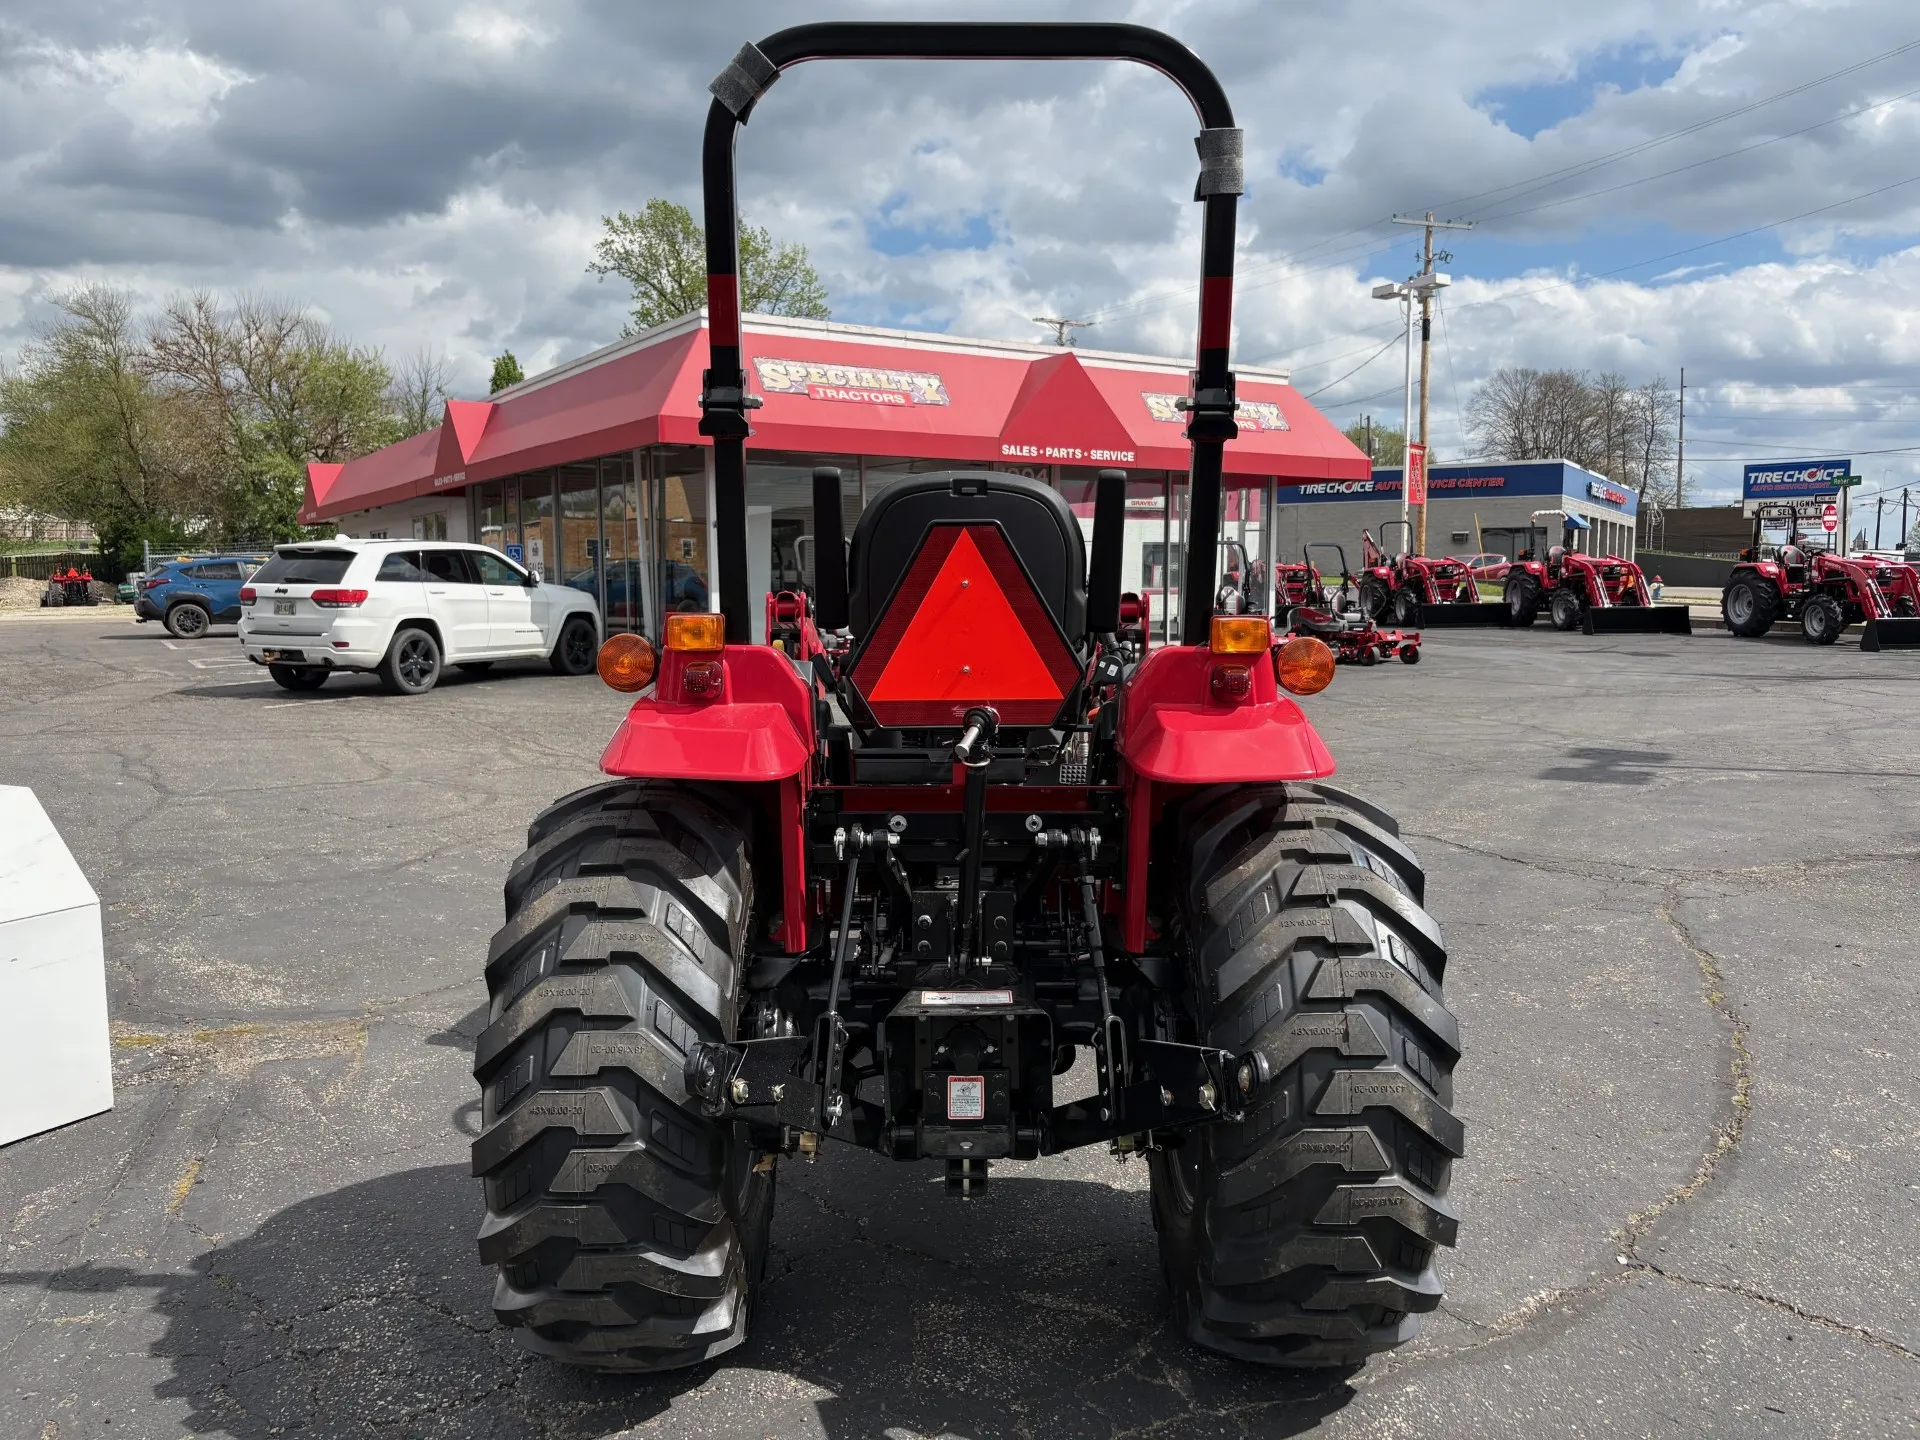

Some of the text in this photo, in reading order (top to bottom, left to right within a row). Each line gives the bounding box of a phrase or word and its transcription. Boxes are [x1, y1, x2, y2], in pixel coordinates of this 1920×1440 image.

[759, 363, 942, 401] SPECIALTY
[815, 387, 905, 404] TRACTORS
[1002, 444, 1134, 461] SALES PARTS SERVICE
[1458, 477, 1505, 488] CENTER
[1751, 509, 1772, 517] WTH
[1777, 508, 1808, 516] SELCT
